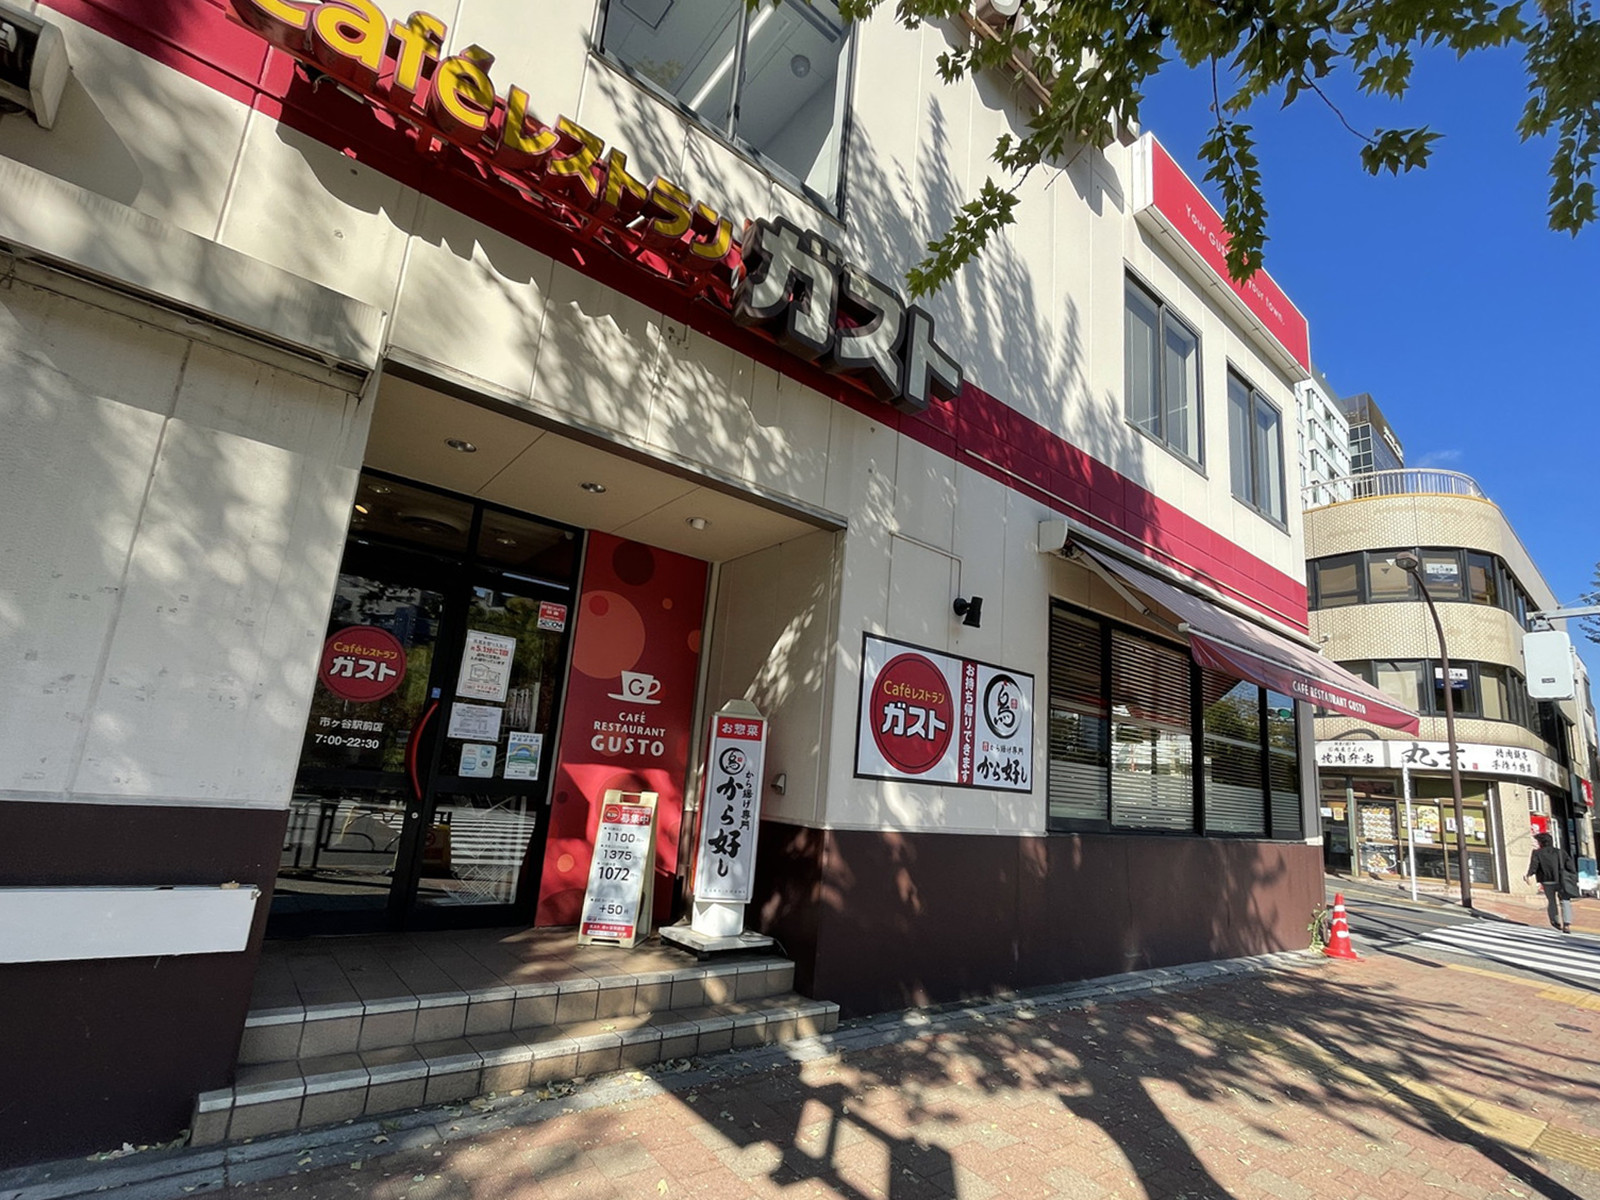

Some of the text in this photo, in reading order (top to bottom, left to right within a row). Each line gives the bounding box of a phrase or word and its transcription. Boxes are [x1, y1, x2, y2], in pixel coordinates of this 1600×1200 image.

[740, 217, 963, 406] ガスト
[329, 656, 397, 682] ガスト
[1309, 686, 1348, 708] RESTAURANT
[1347, 698, 1366, 715] GUSTO
[593, 720, 666, 737] RESTAURANT
[618, 711, 647, 724] CAFÉ
[721, 722, 760, 737] お惣菜
[881, 702, 947, 741] ガスト
[590, 734, 665, 757] GUSTO
[976, 755, 1028, 785] から好し
[739, 770, 755, 831] から揚げ専門
[708, 776, 744, 877] から好し
